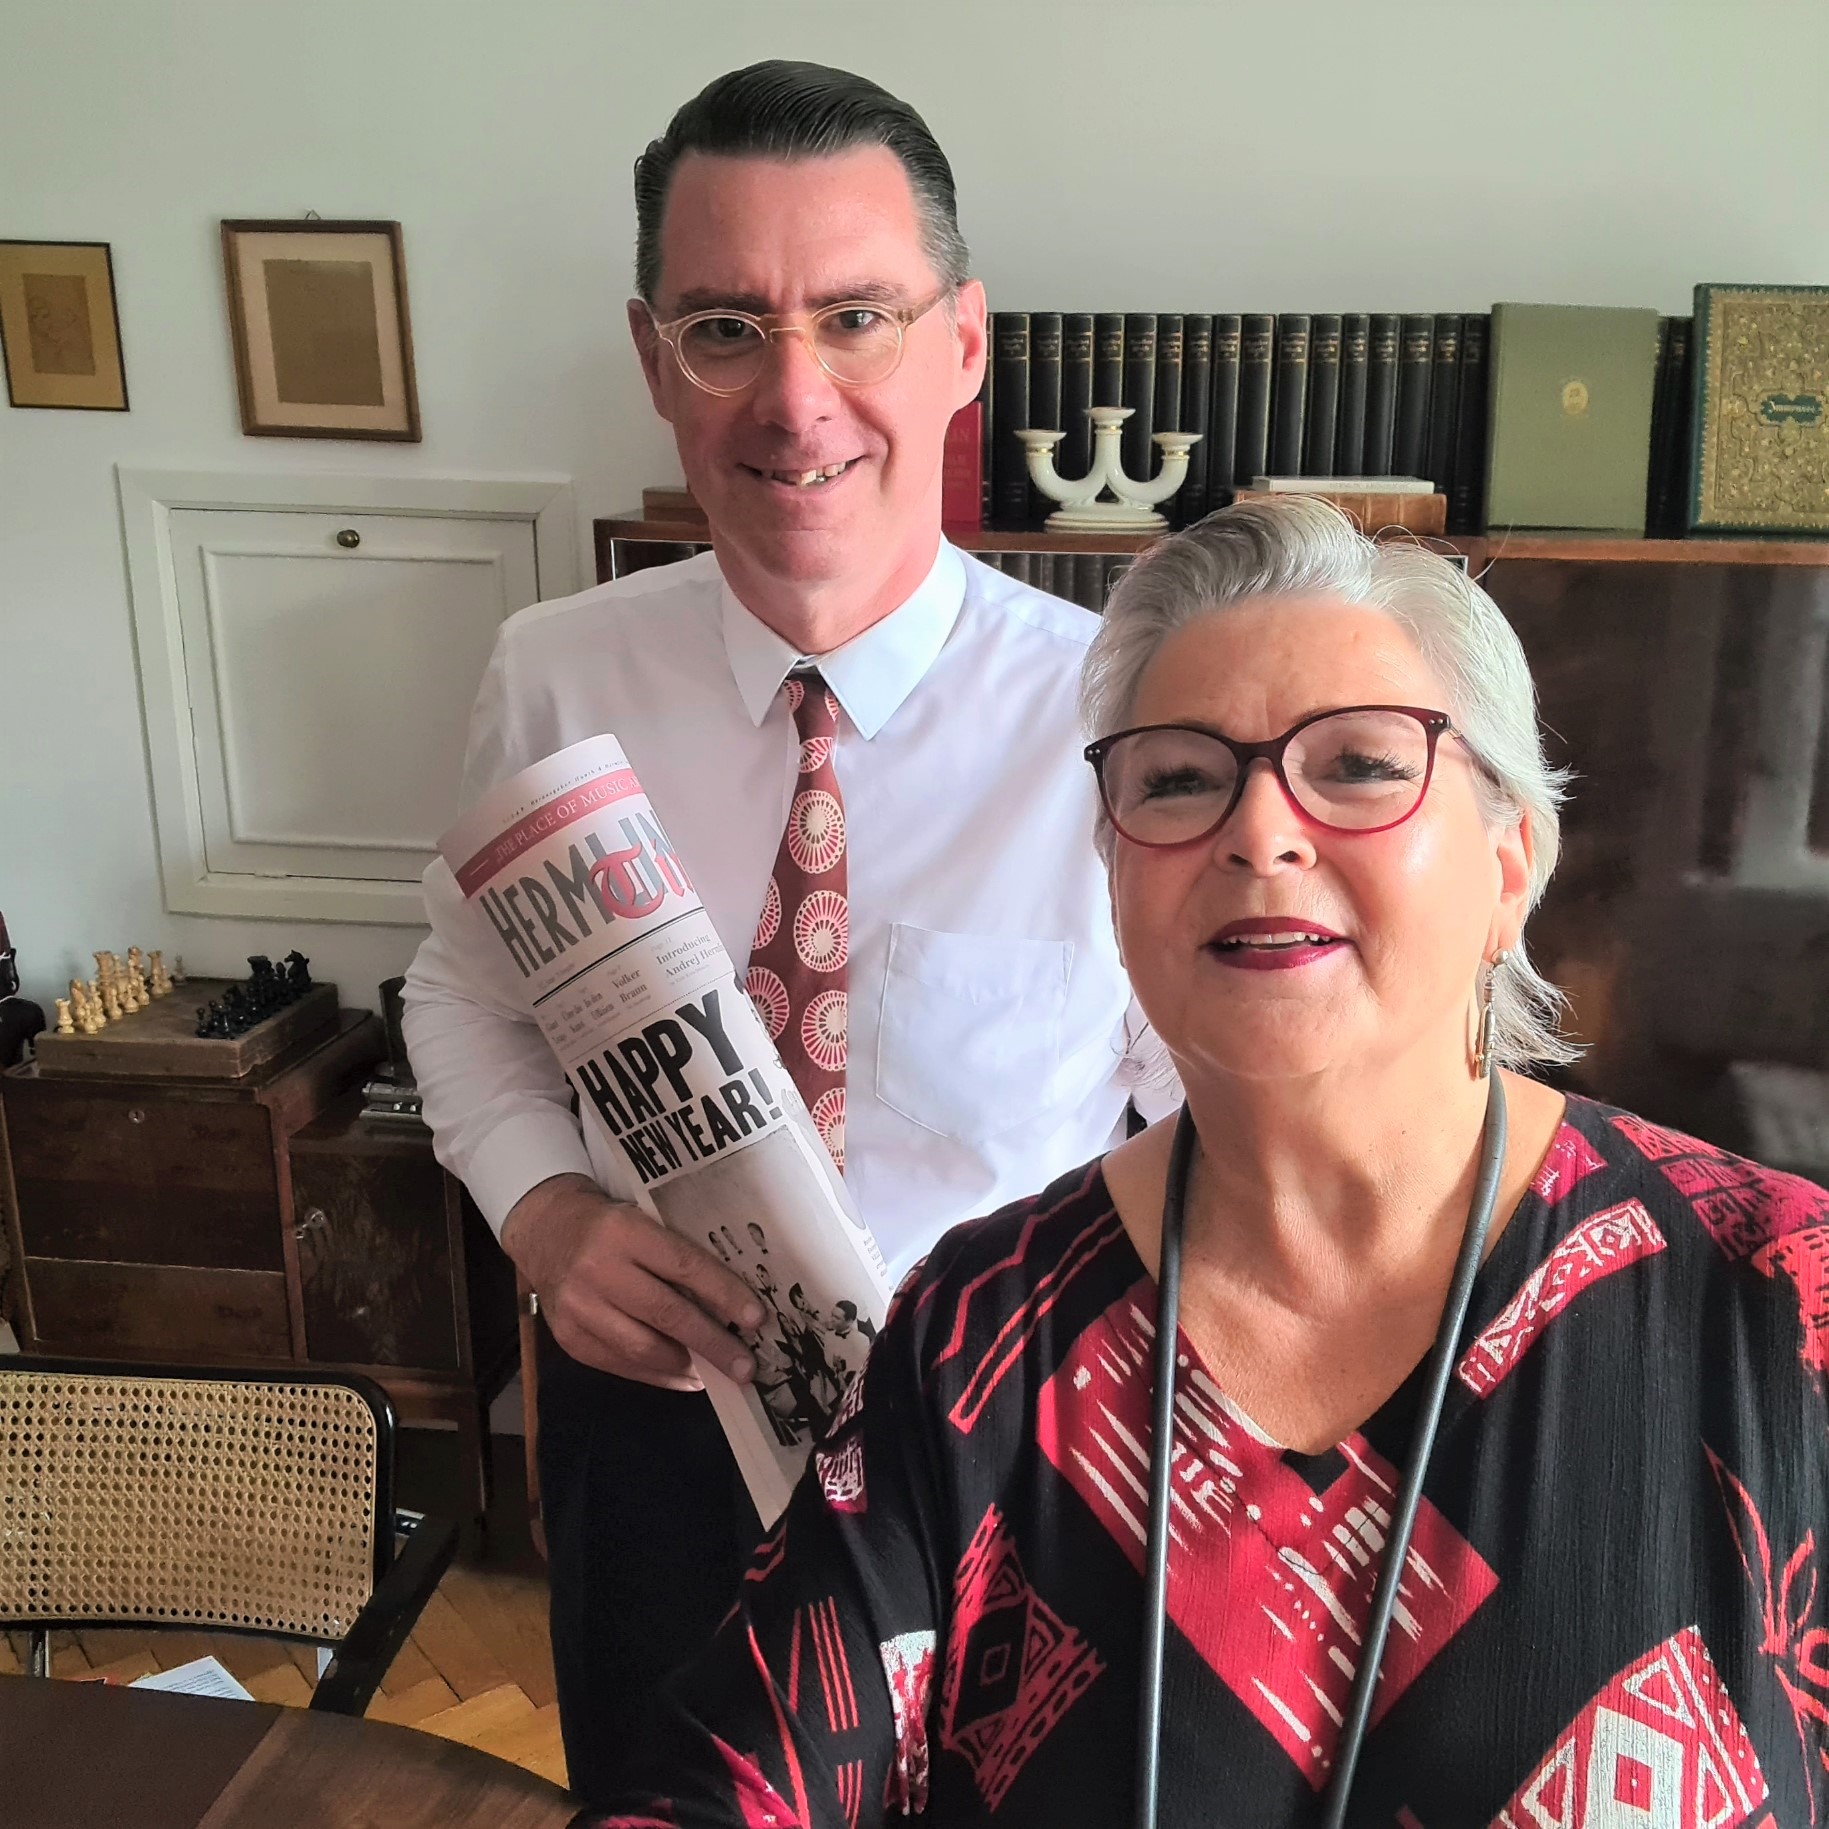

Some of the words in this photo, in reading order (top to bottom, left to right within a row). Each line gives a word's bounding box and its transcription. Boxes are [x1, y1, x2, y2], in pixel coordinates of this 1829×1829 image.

[495, 839, 516, 861] THE
[515, 813, 556, 846] PLACE
[556, 800, 580, 820] OF
[582, 778, 629, 808] MUSIC
[656, 934, 711, 965] Introducing
[611, 969, 641, 989] Volker
[665, 953, 701, 978] Andrej
[619, 983, 648, 1004] Braun
[576, 989, 745, 1136] HAPPY
[619, 1120, 683, 1185] NEW
[664, 1067, 784, 1162] YEAR!
